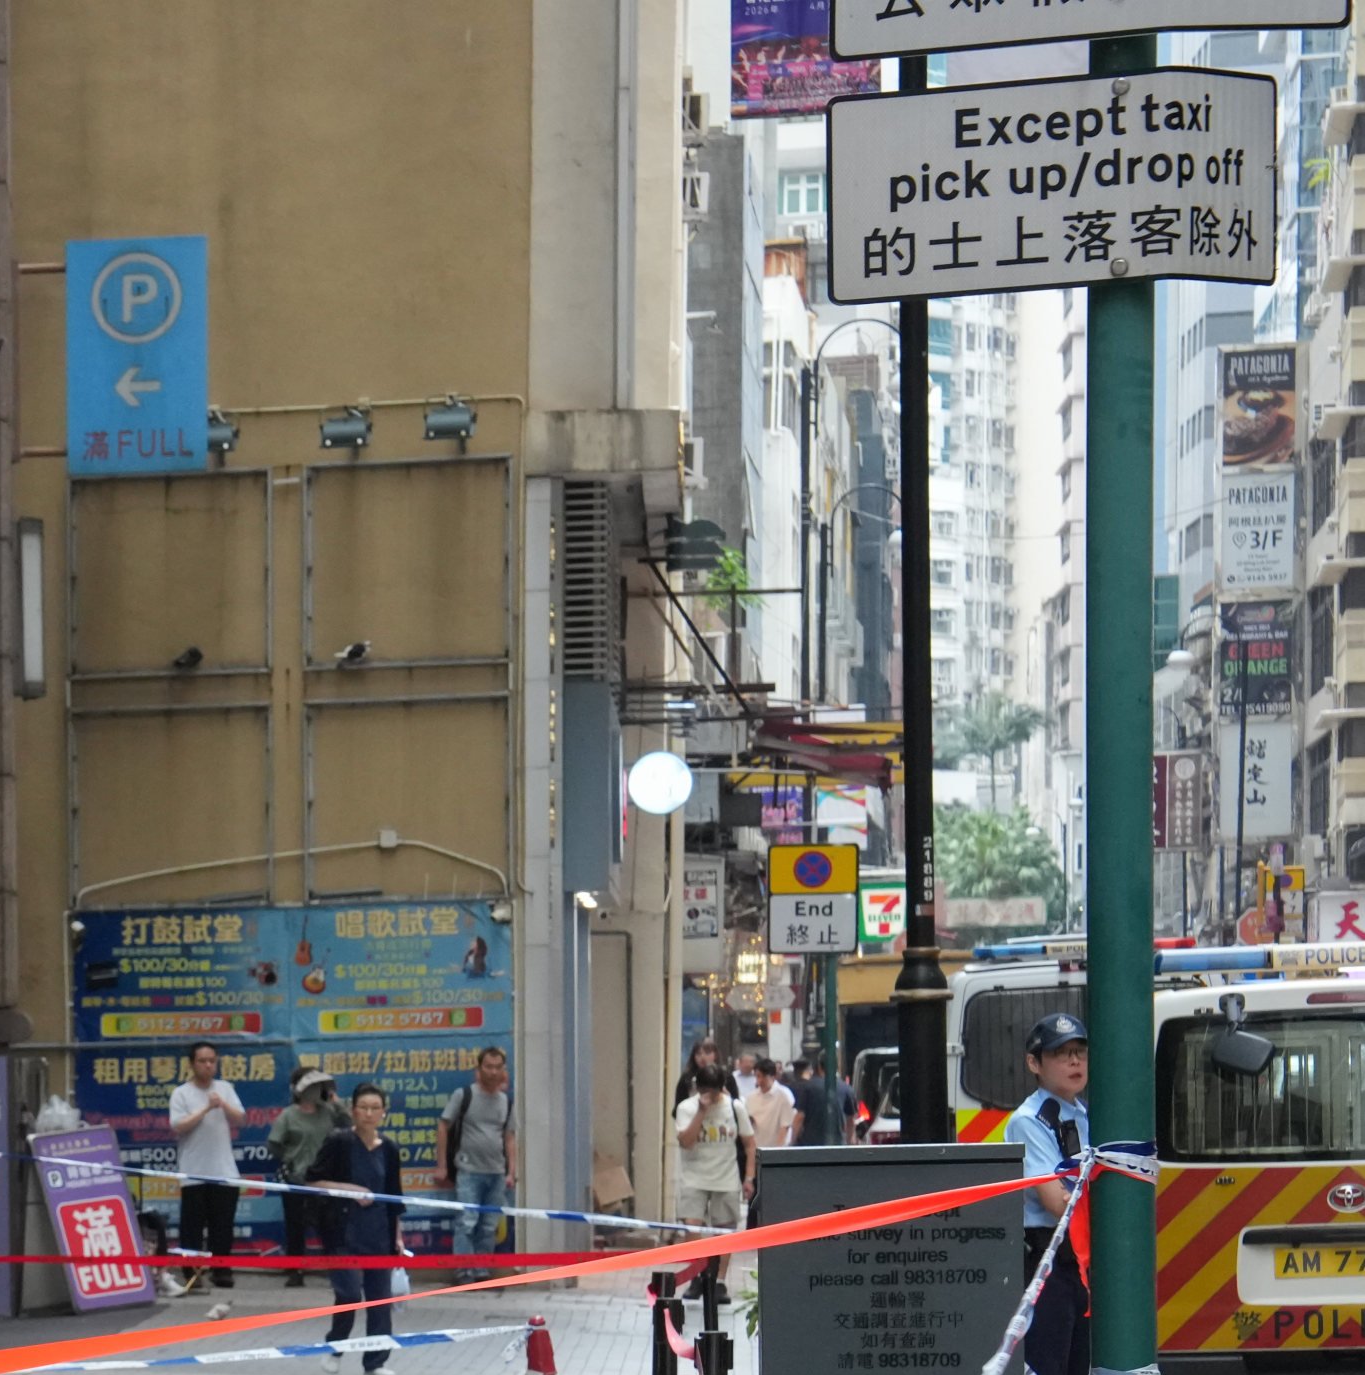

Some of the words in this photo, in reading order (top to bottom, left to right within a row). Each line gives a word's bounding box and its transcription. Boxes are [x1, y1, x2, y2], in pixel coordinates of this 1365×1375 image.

[955, 95, 1126, 148] Except
[1141, 93, 1212, 133] taxi
[890, 159, 990, 212] pick
[1009, 148, 1196, 201] up/drop
[1206, 148, 1244, 186] off
[863, 204, 1258, 279] 的士上落客除外
[121, 273, 157, 323] P
[1230, 353, 1290, 375] PATAGONIA
[81, 430, 110, 460] 滿
[117, 428, 194, 459] FULL
[1229, 485, 1288, 505] PATAGONIA
[1250, 529, 1283, 550] 3/F
[1228, 641, 1284, 660] GEEN
[795, 900, 833, 917] End
[121, 914, 244, 945] 打鼓試堂
[335, 906, 459, 938] 唱歌試堂
[786, 924, 839, 946] 終止
[72, 1204, 122, 1258] 滿
[910, 1225, 924, 1240] in
[931, 1226, 1006, 1244] progress
[847, 1248, 870, 1264] for
[875, 1248, 948, 1266] enquires
[1282, 1250, 1321, 1274] AM
[77, 1263, 142, 1292] FULL
[870, 1270, 898, 1285] call
[904, 1268, 987, 1285] 98318709
[870, 1291, 926, 1309] 運輸署
[833, 1311, 964, 1329] 交通調查進行中
[860, 1332, 935, 1349] 如有查詢
[837, 1352, 874, 1369] 請電
[878, 1352, 961, 1368] 98318709
